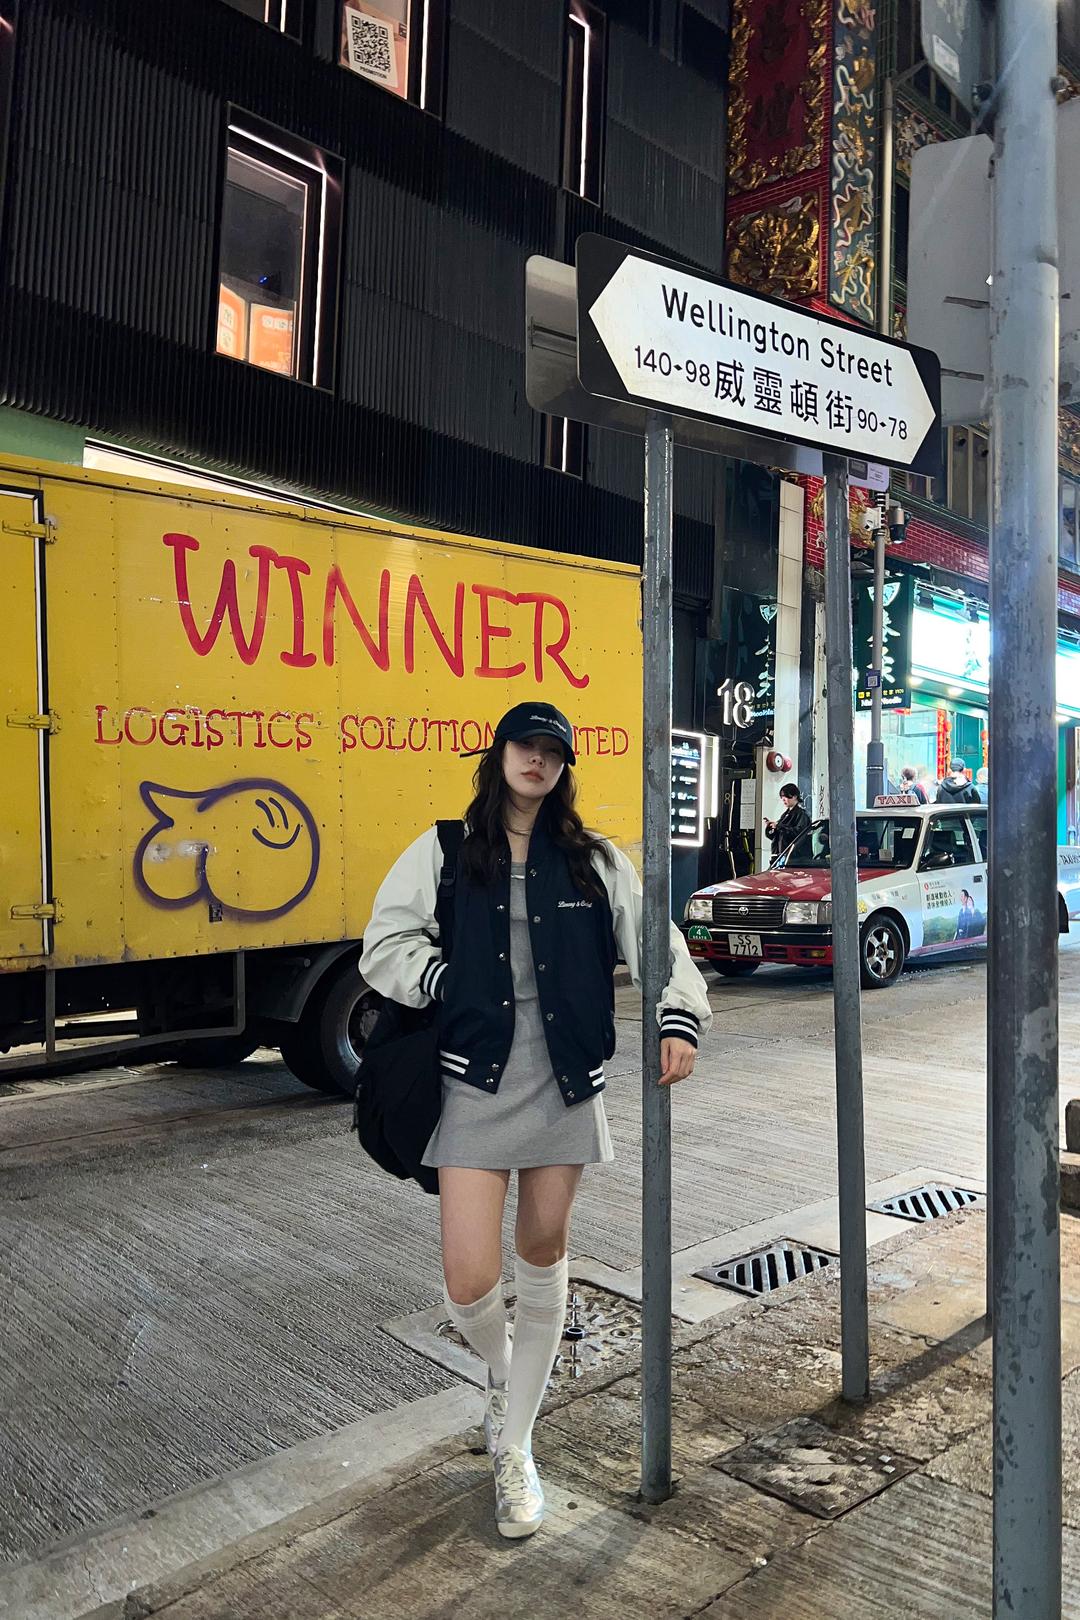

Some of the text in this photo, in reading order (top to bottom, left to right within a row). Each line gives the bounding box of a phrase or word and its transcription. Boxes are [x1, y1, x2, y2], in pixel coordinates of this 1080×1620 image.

[662, 284, 892, 387] Wellington Street
[714, 360, 852, 434] 威靈頓街
[162, 532, 590, 689] WINNER
[717, 678, 755, 728] 18
[94, 705, 314, 751] LOGISTICS
[572, 725, 629, 756] ITED
[877, 795, 912, 805] TAXI
[733, 944, 759, 955] 7712
[737, 934, 752, 945] SS
